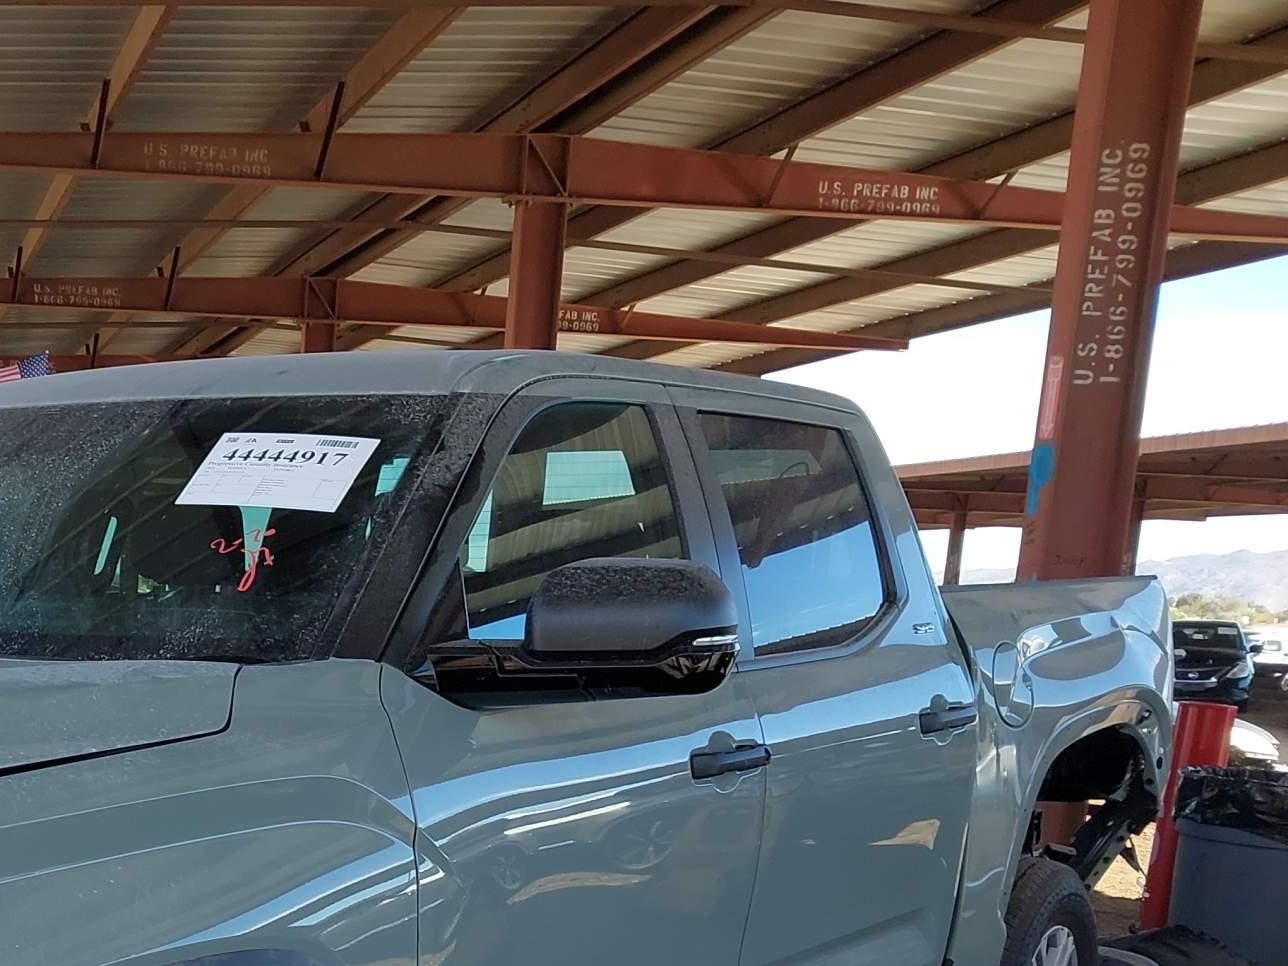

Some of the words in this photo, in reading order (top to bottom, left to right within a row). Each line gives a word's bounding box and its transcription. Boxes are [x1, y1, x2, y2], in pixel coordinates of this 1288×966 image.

[853, 182, 909, 198] PREFAB
[1081, 208, 1115, 316] PREFAB
[1099, 143, 1151, 384] 1-866-799-0969
[1072, 333, 1100, 385] U.S.
[222, 448, 349, 466] 44444917
